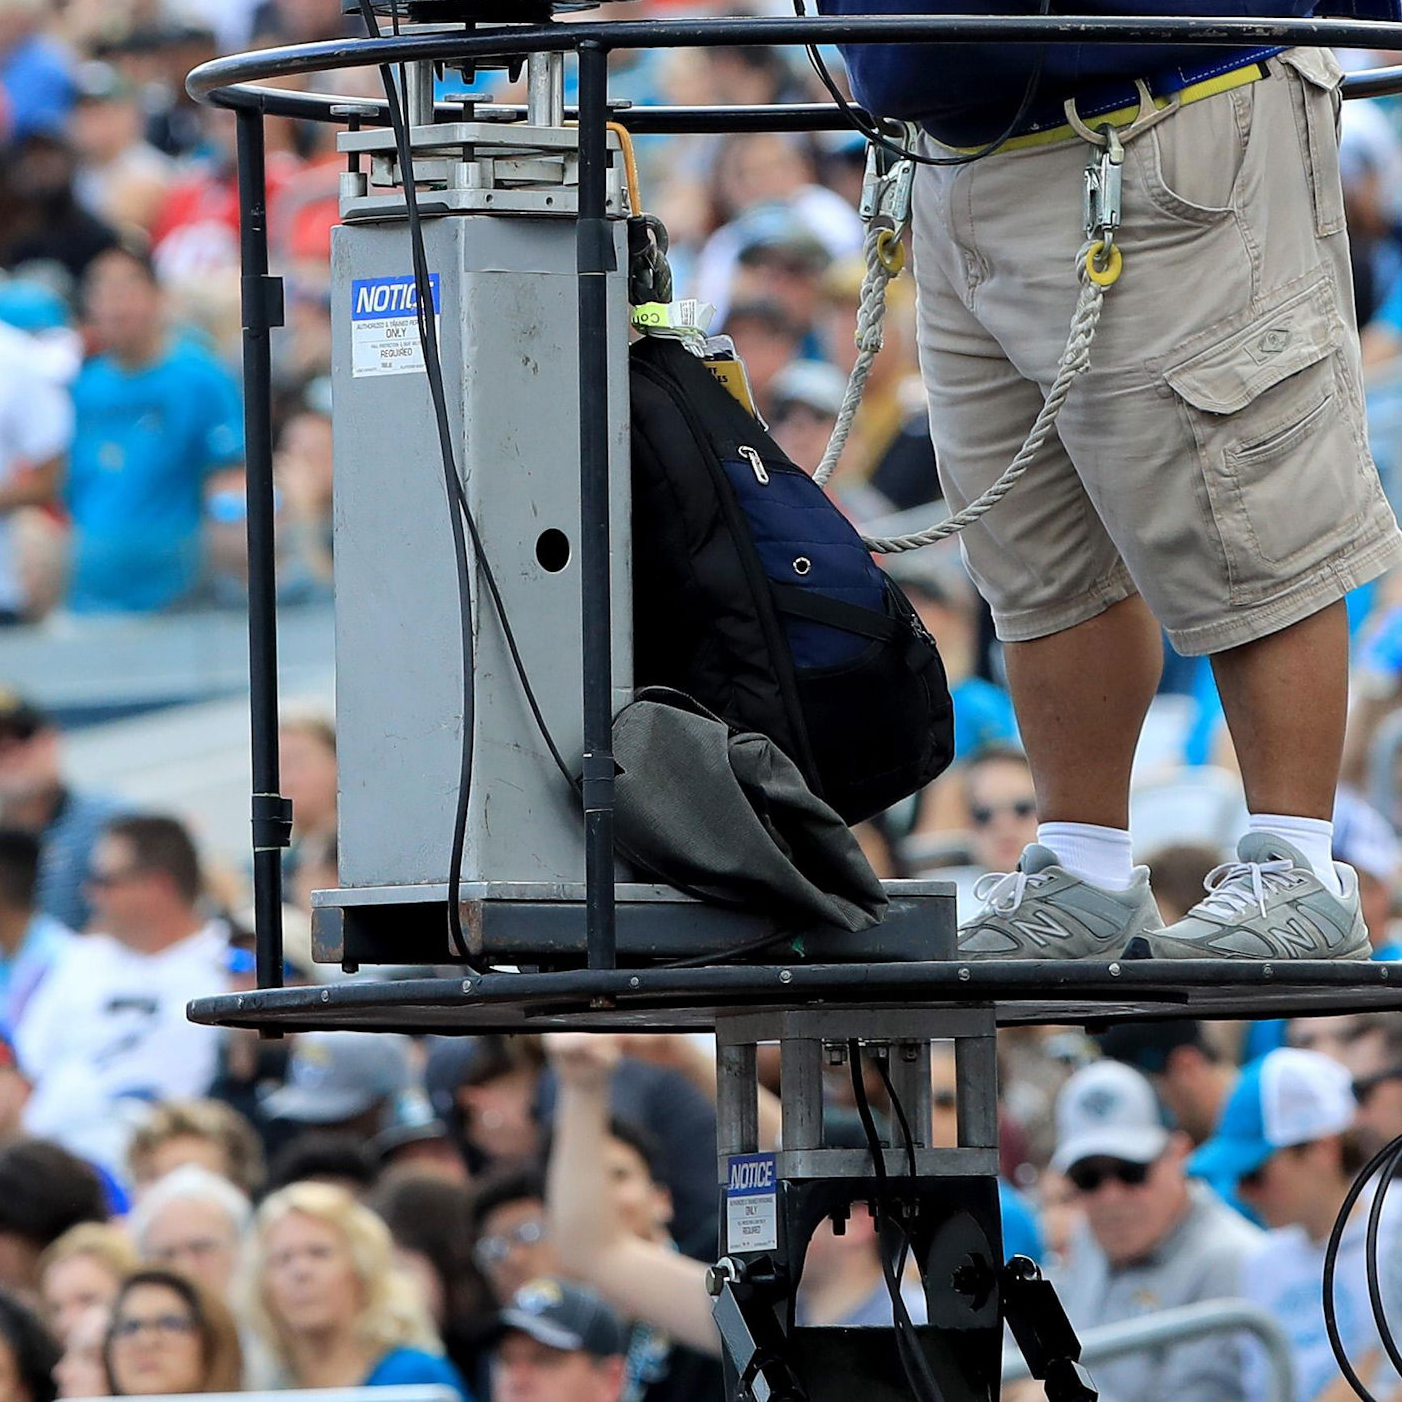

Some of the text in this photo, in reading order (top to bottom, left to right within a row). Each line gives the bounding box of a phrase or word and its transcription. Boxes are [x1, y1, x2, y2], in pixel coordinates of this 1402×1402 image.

[356, 281, 435, 313] NOTIC
[385, 328, 407, 338] ONLY
[729, 1160, 774, 1191] NOTICE
